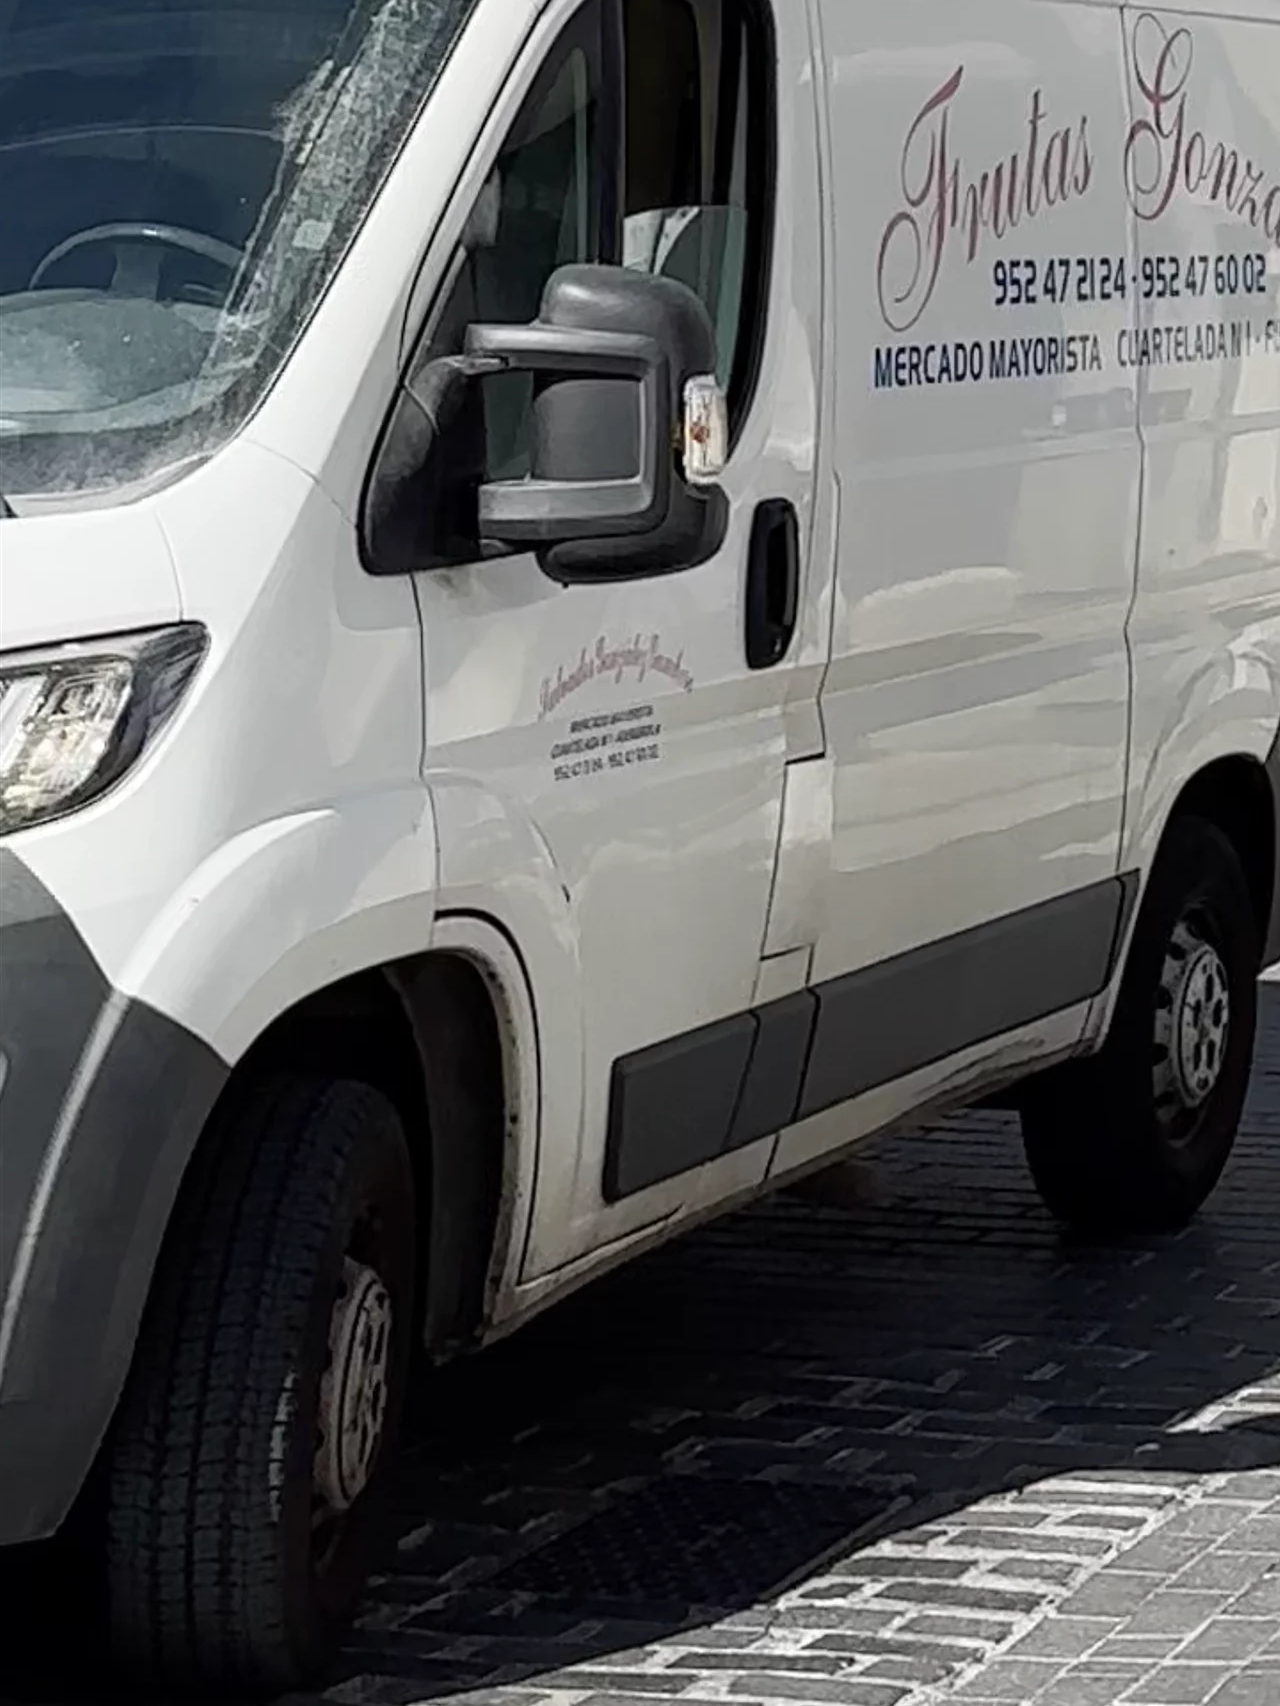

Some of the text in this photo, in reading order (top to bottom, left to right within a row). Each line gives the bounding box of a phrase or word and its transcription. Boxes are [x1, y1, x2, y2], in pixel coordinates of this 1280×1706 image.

[877, 64, 1095, 332] Frutas
[993, 259, 1038, 307] 952
[1043, 258, 1071, 304] 47
[1076, 257, 1096, 302] 21
[1099, 256, 1127, 300] 24
[1142, 256, 1180, 298] 952
[1184, 255, 1209, 297] 47
[1214, 254, 1238, 295] 60
[1242, 253, 1267, 293] 02
[874, 340, 984, 389] MERCADO
[989, 333, 1102, 379] MAYORISTA
[1117, 322, 1228, 367] CUARTELADA
